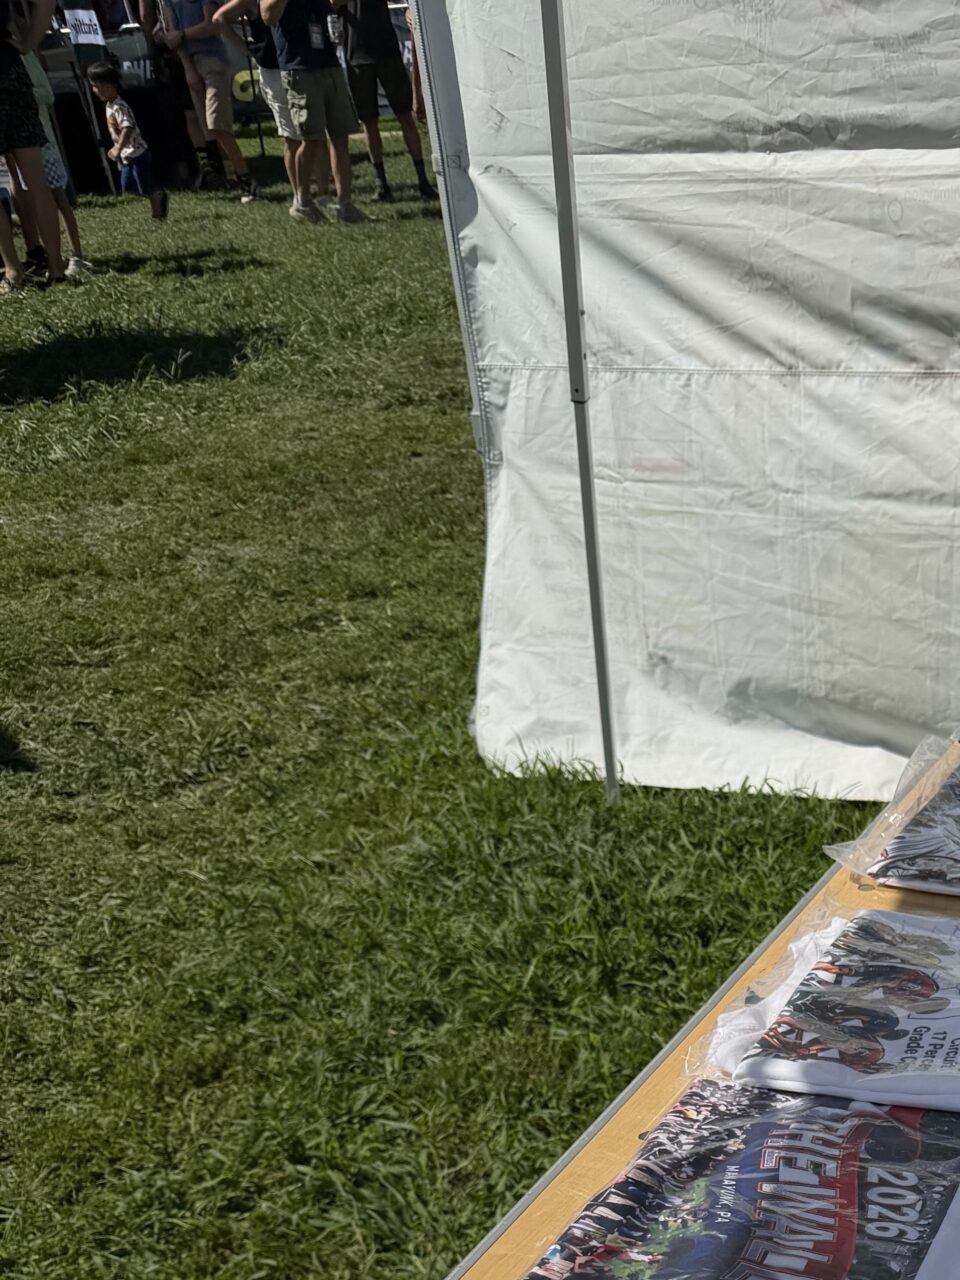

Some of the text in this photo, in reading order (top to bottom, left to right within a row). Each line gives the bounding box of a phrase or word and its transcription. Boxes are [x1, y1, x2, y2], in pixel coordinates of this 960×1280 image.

[903, 1026, 931, 1055] Grade
[931, 1030, 947, 1042] 17
[760, 1121, 850, 1178] THE
[715, 1165, 740, 1223] MANAYUNK, PA
[864, 1167, 920, 1241] 2026
